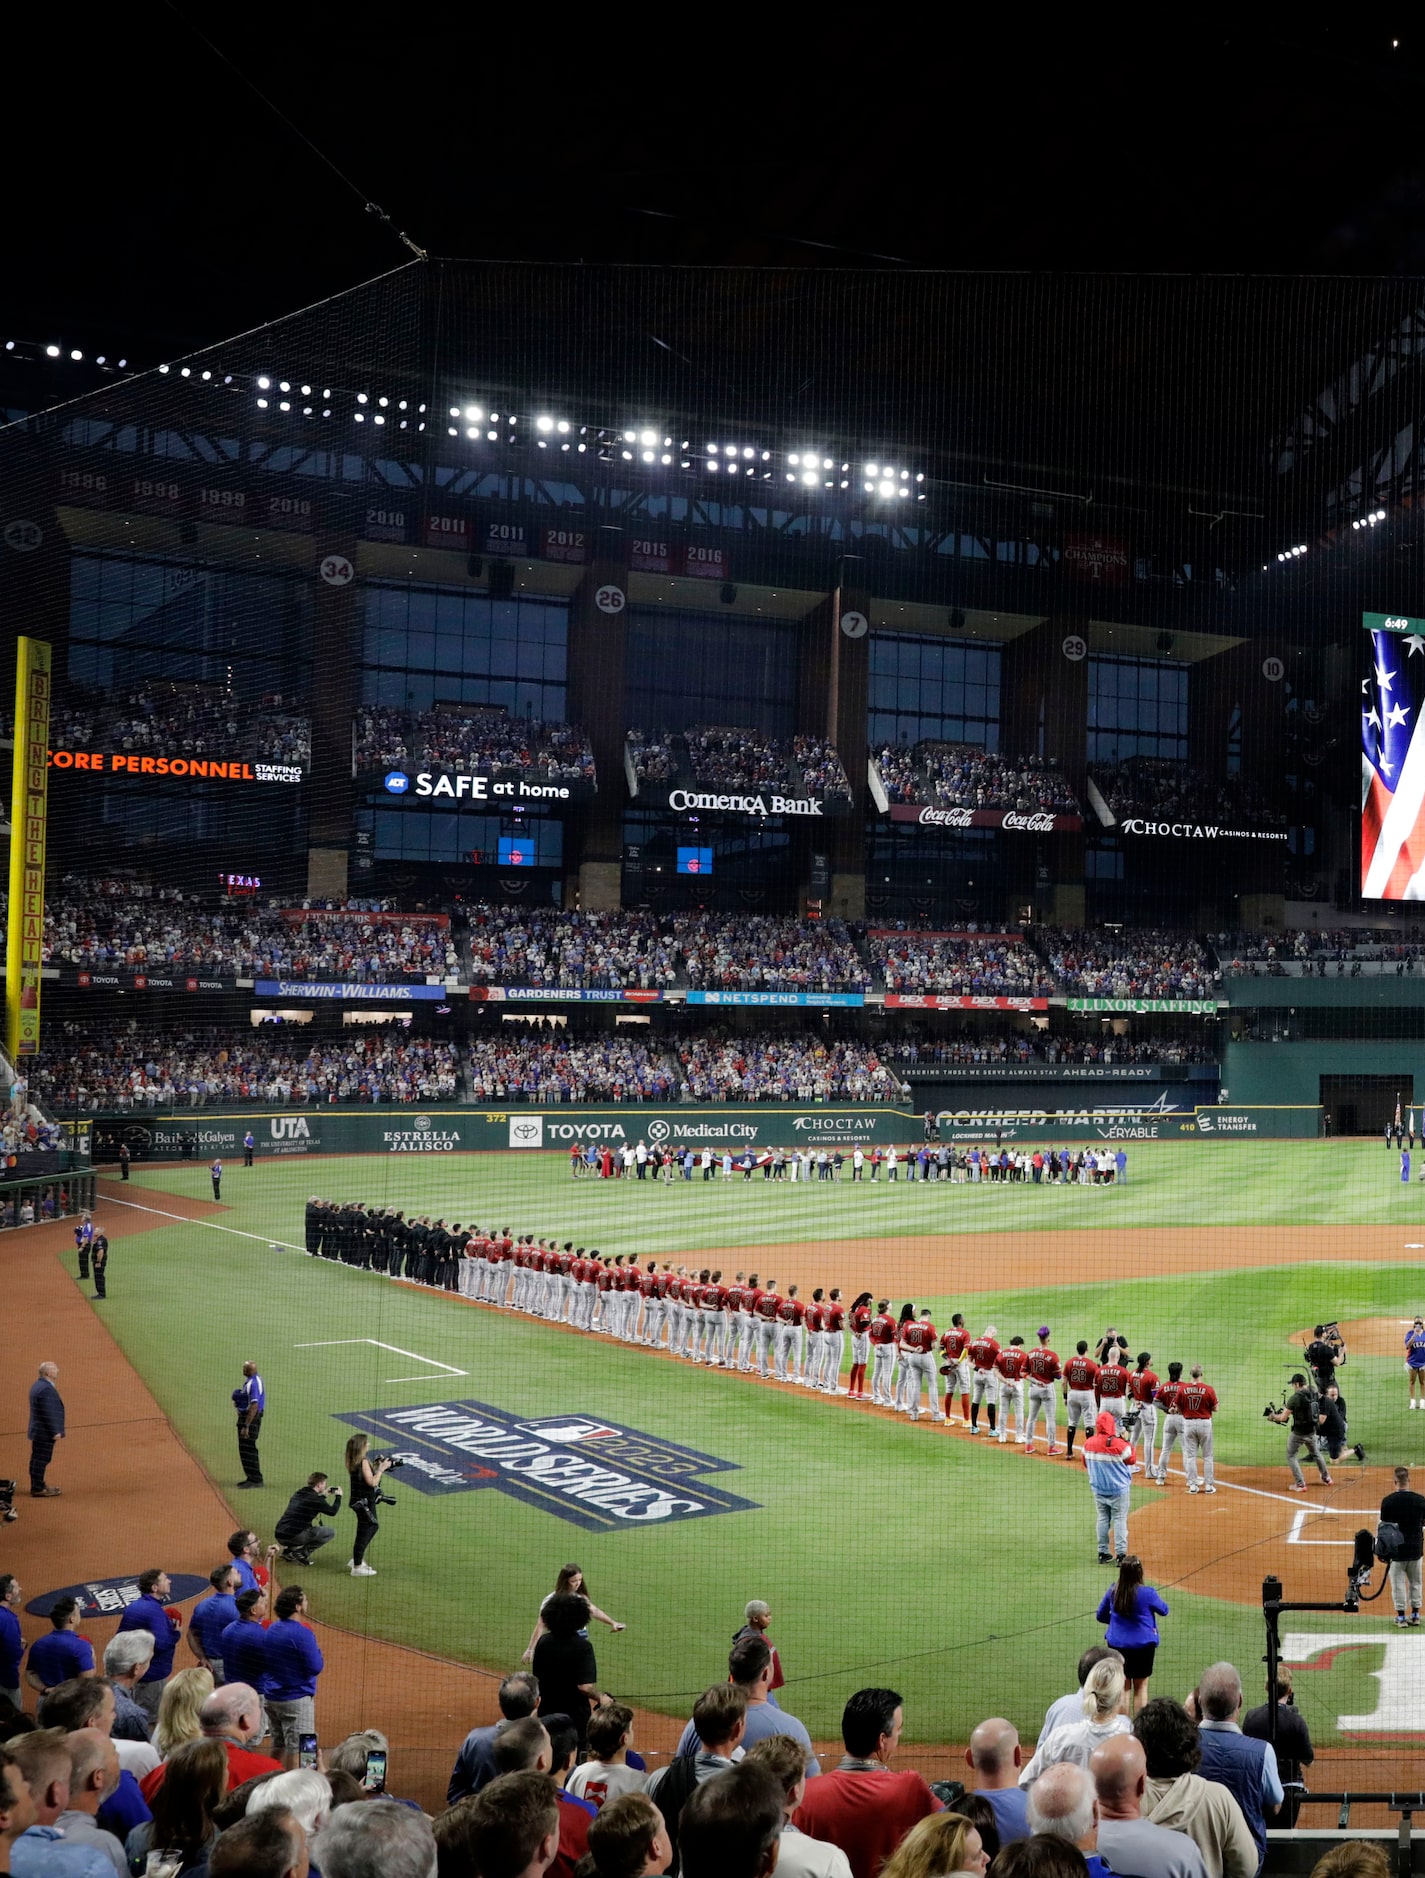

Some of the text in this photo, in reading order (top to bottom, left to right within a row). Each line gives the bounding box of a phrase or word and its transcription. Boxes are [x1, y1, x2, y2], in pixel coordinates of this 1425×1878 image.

[365, 509, 405, 527] 2010
[430, 515, 466, 534] 2011
[489, 523, 524, 541] 2011
[548, 530, 585, 548] 2012
[633, 539, 668, 557] 2015
[688, 546, 722, 564] 2016
[323, 563, 350, 580] 34
[598, 591, 623, 609] 26
[849, 616, 861, 633] 7
[1384, 617, 1408, 630] 6:49
[1064, 640, 1085, 656] 29
[1266, 661, 1280, 677] 10
[111, 755, 254, 780] PERSONNEL
[255, 764, 302, 775] STAFFING
[256, 772, 302, 783] SERVICES
[415, 774, 570, 800] SAFE at home
[771, 795, 824, 816] Bank
[918, 805, 974, 827] Coca-Cola
[1002, 811, 1057, 831] Coca-Cola
[29, 797, 41, 862] THE
[1131, 819, 1288, 840] CHOCTAW CASINOS RESORTS
[217, 873, 262, 888] TEXAS
[27, 872, 39, 960] HEAT
[92, 976, 119, 984] TOYOTA
[148, 978, 173, 987] TOYOTA
[199, 981, 222, 989] TOYOTA
[508, 988, 582, 999] GARDENERS
[585, 989, 622, 1000] TRUST
[723, 994, 798, 1004] NETSPEND
[899, 994, 925, 1003] DEX
[936, 995, 962, 1004] DEX
[972, 996, 997, 1005] DEX
[1007, 996, 1032, 1005] DEX
[1080, 999, 1214, 1013] LUXOR STAFFING
[1063, 1069, 1104, 1077] AHEAD
[1112, 1069, 1152, 1077] READY
[486, 1114, 506, 1124] 372
[801, 1117, 876, 1129] CHOCTAW
[1217, 1116, 1249, 1124] ENERGY
[270, 1116, 311, 1139] UTA
[547, 1124, 626, 1139] TOYOTA
[673, 1123, 758, 1141] Medical City
[1180, 1123, 1195, 1132] 410
[1217, 1123, 1257, 1131] TRANSFER
[384, 1131, 460, 1142] ESTRELLA
[390, 1141, 453, 1151] JALISCO
[1006, 1358, 1015, 1373] 5
[1032, 1358, 1045, 1373] 12
[1070, 1367, 1087, 1383] 28
[1101, 1376, 1119, 1392] 53
[1187, 1395, 1202, 1411] 17
[385, 1405, 705, 1520] WORLD SERIES
[586, 1438, 699, 1474] 2023
